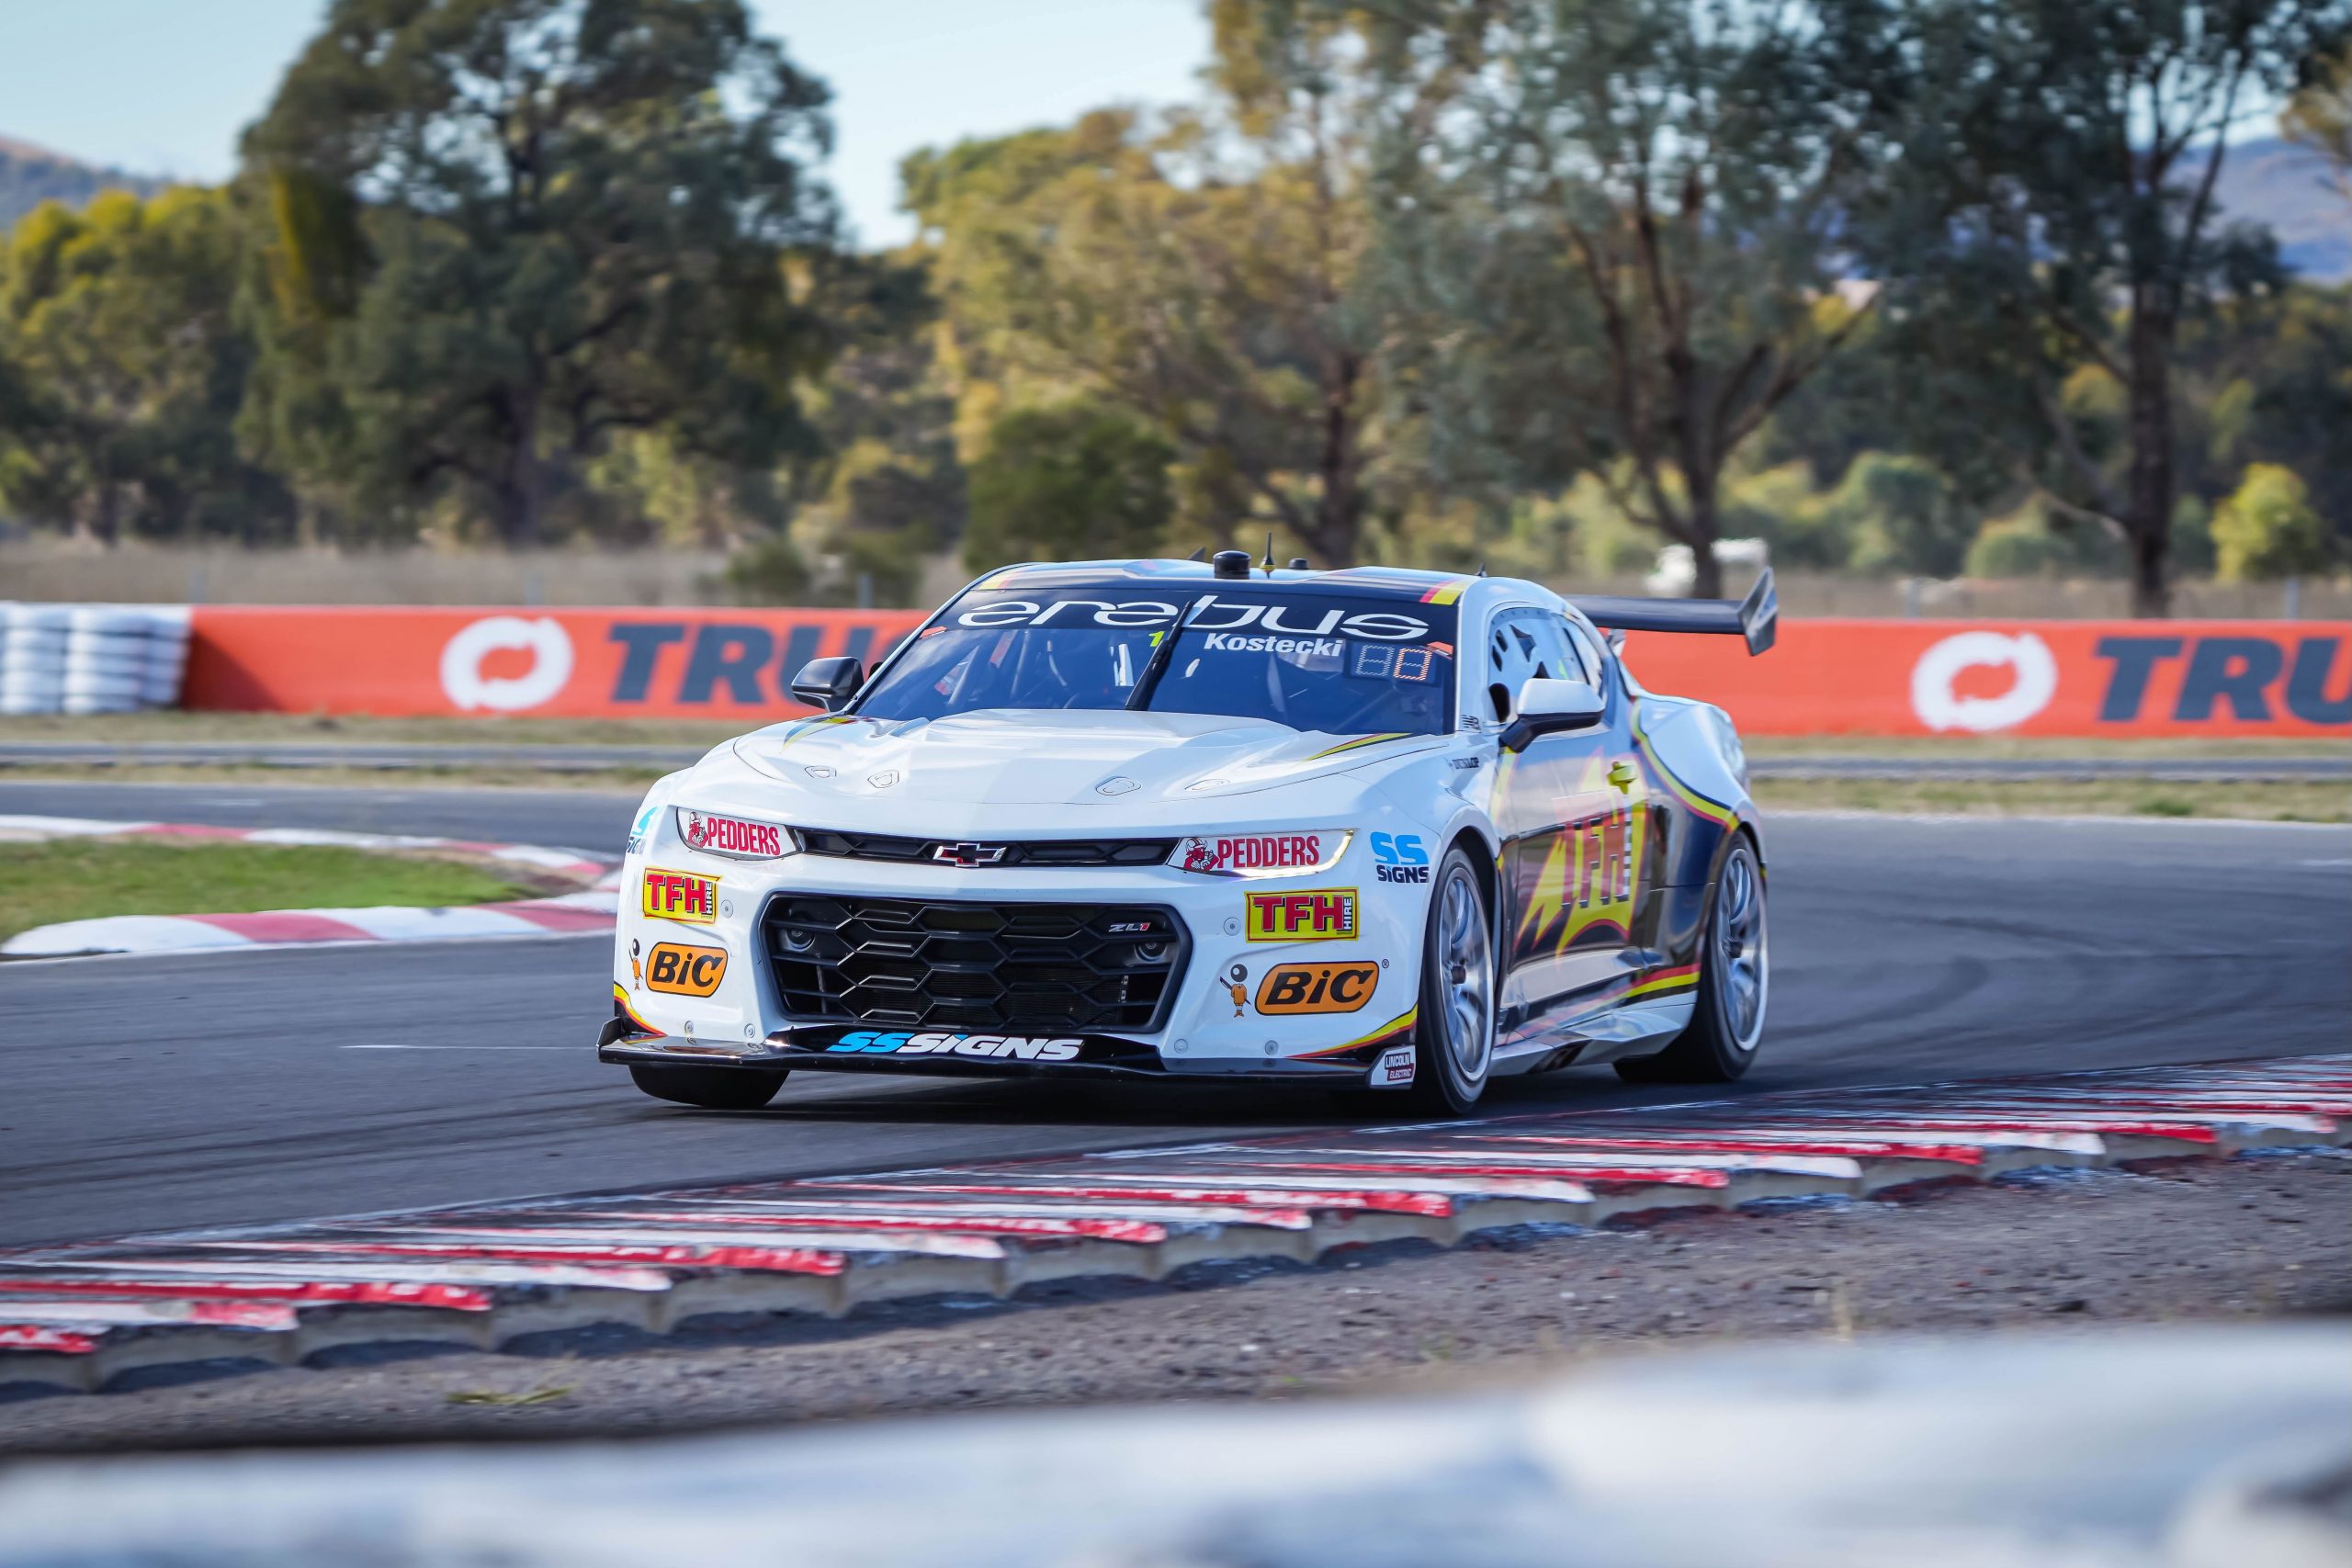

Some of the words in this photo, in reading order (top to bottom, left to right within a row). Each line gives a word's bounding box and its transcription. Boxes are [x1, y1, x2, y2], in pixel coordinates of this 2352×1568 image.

[958, 595, 1430, 640] erebus
[1204, 633, 1343, 657] Kostecki
[607, 624, 908, 706] TRU
[707, 817, 780, 856] PEDDERS
[1217, 835, 1320, 869] PEDDERS
[1370, 831, 1429, 865] SS
[646, 874, 707, 914] TFH
[706, 881, 714, 915] HIRE
[1108, 922, 1151, 932] ZL1
[1253, 895, 1344, 931] TFH
[1343, 897, 1352, 931] HIRE
[1385, 1054, 1410, 1067] LINCOLN
